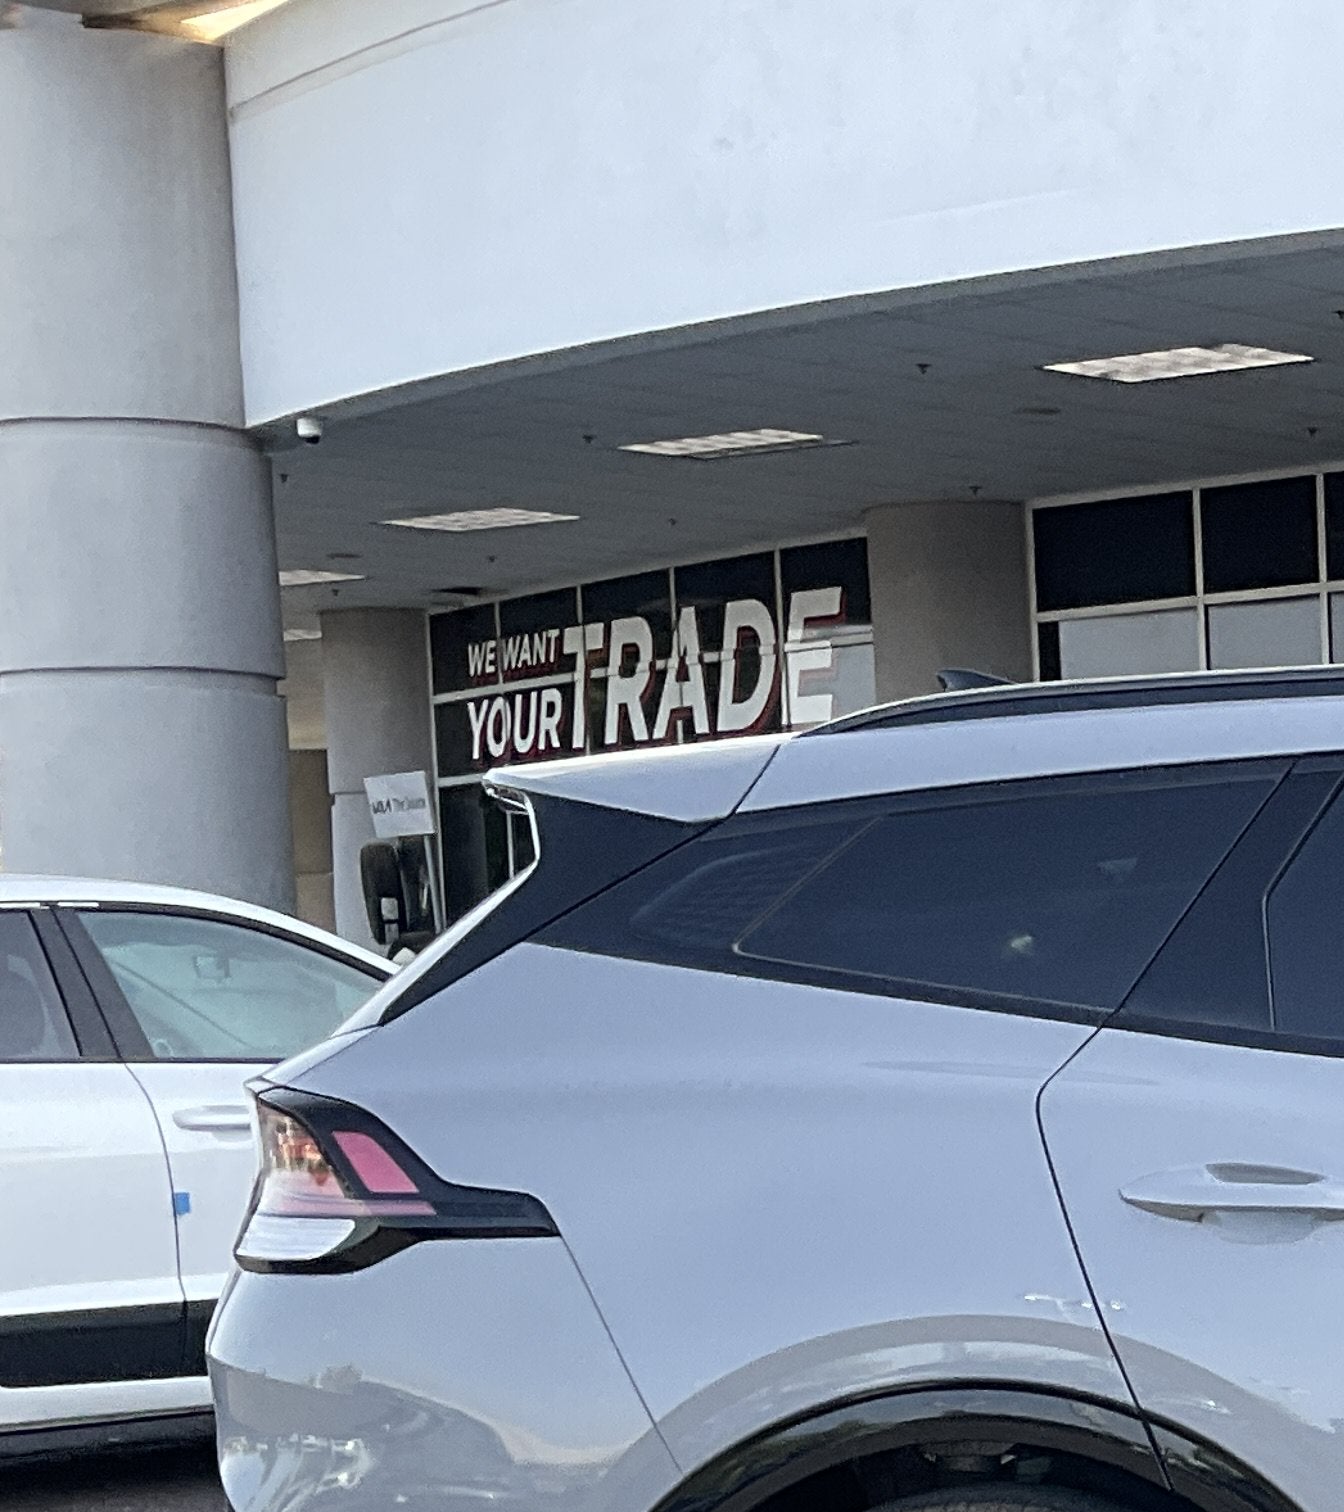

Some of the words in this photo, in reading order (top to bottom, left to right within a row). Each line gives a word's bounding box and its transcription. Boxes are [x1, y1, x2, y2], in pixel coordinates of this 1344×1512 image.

[467, 638, 497, 677] WE
[500, 628, 561, 670] WANT
[467, 687, 563, 760] YOUR
[563, 586, 843, 749] TRADE
